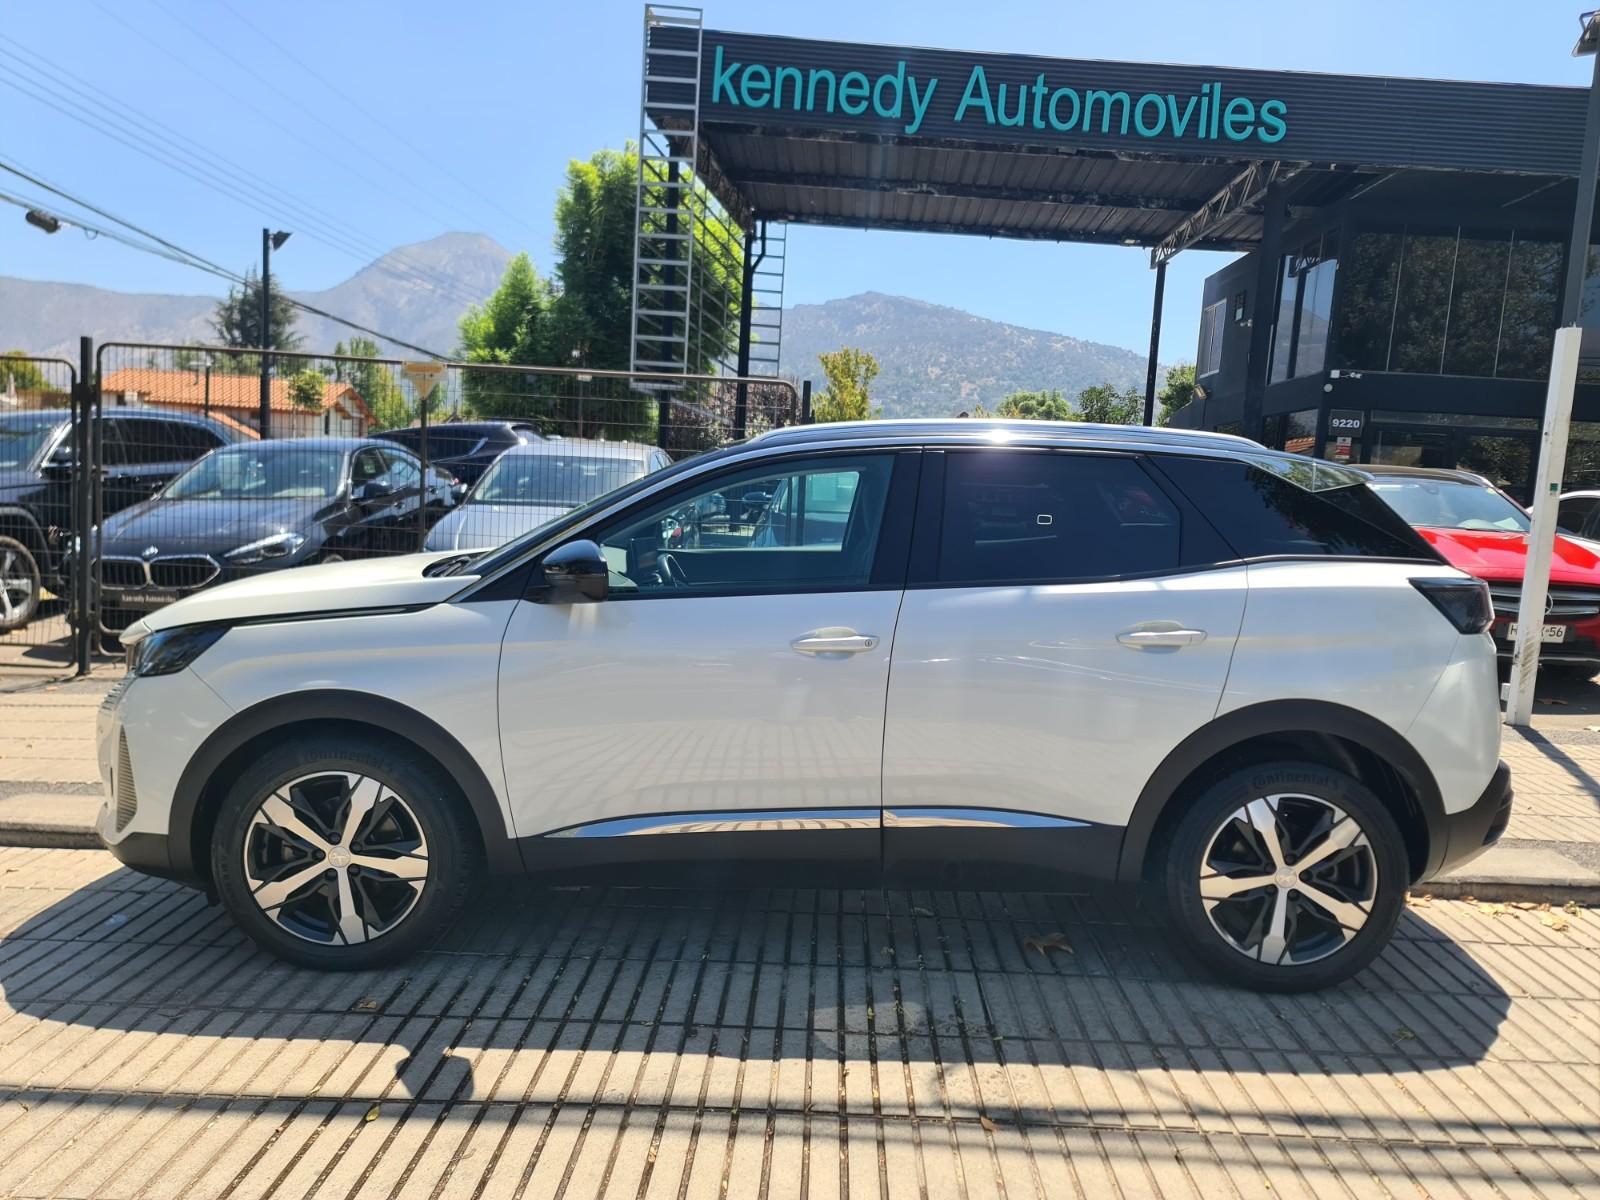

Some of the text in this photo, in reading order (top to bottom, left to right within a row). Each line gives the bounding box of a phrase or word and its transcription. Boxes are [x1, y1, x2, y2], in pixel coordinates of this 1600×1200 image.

[712, 45, 1288, 143] kennedy Automoviles
[1331, 418, 1360, 429] 9220
